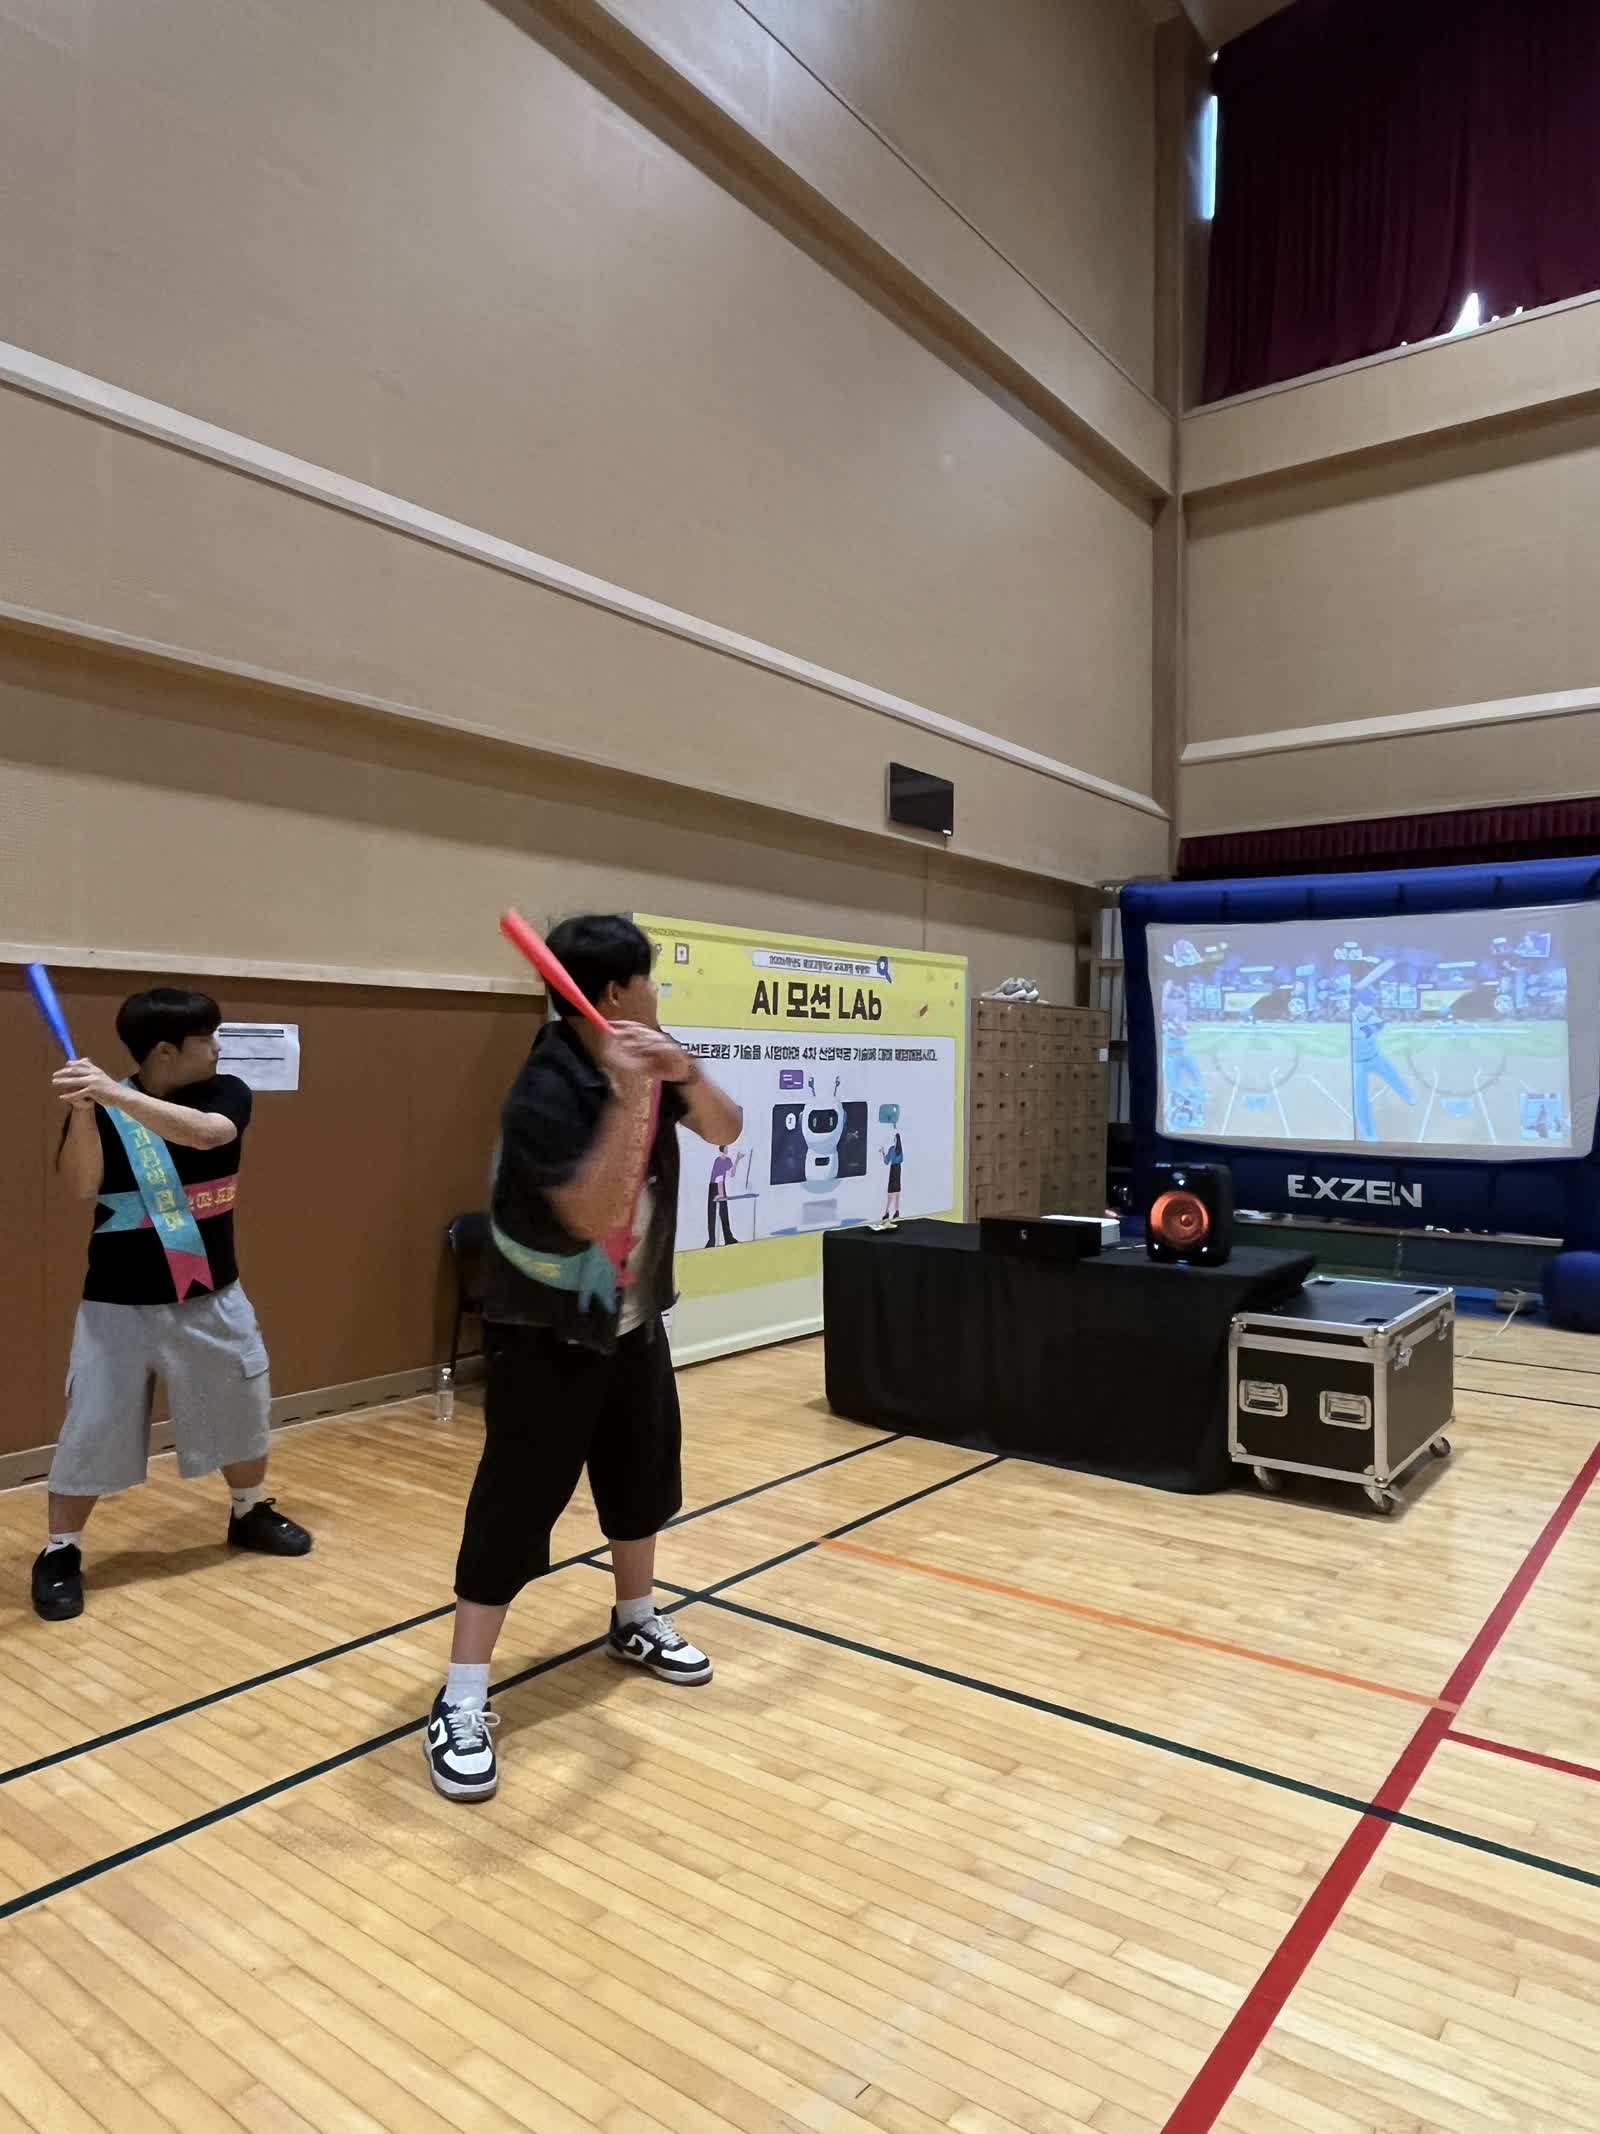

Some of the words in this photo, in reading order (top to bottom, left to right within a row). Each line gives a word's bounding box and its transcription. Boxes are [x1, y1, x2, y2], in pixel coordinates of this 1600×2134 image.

[752, 980, 779, 1015] AI
[786, 982, 831, 1019] 모션
[838, 986, 882, 1020] LAb
[733, 1044, 762, 1061] 기술을
[1287, 1174, 1423, 1208] EXZEN
